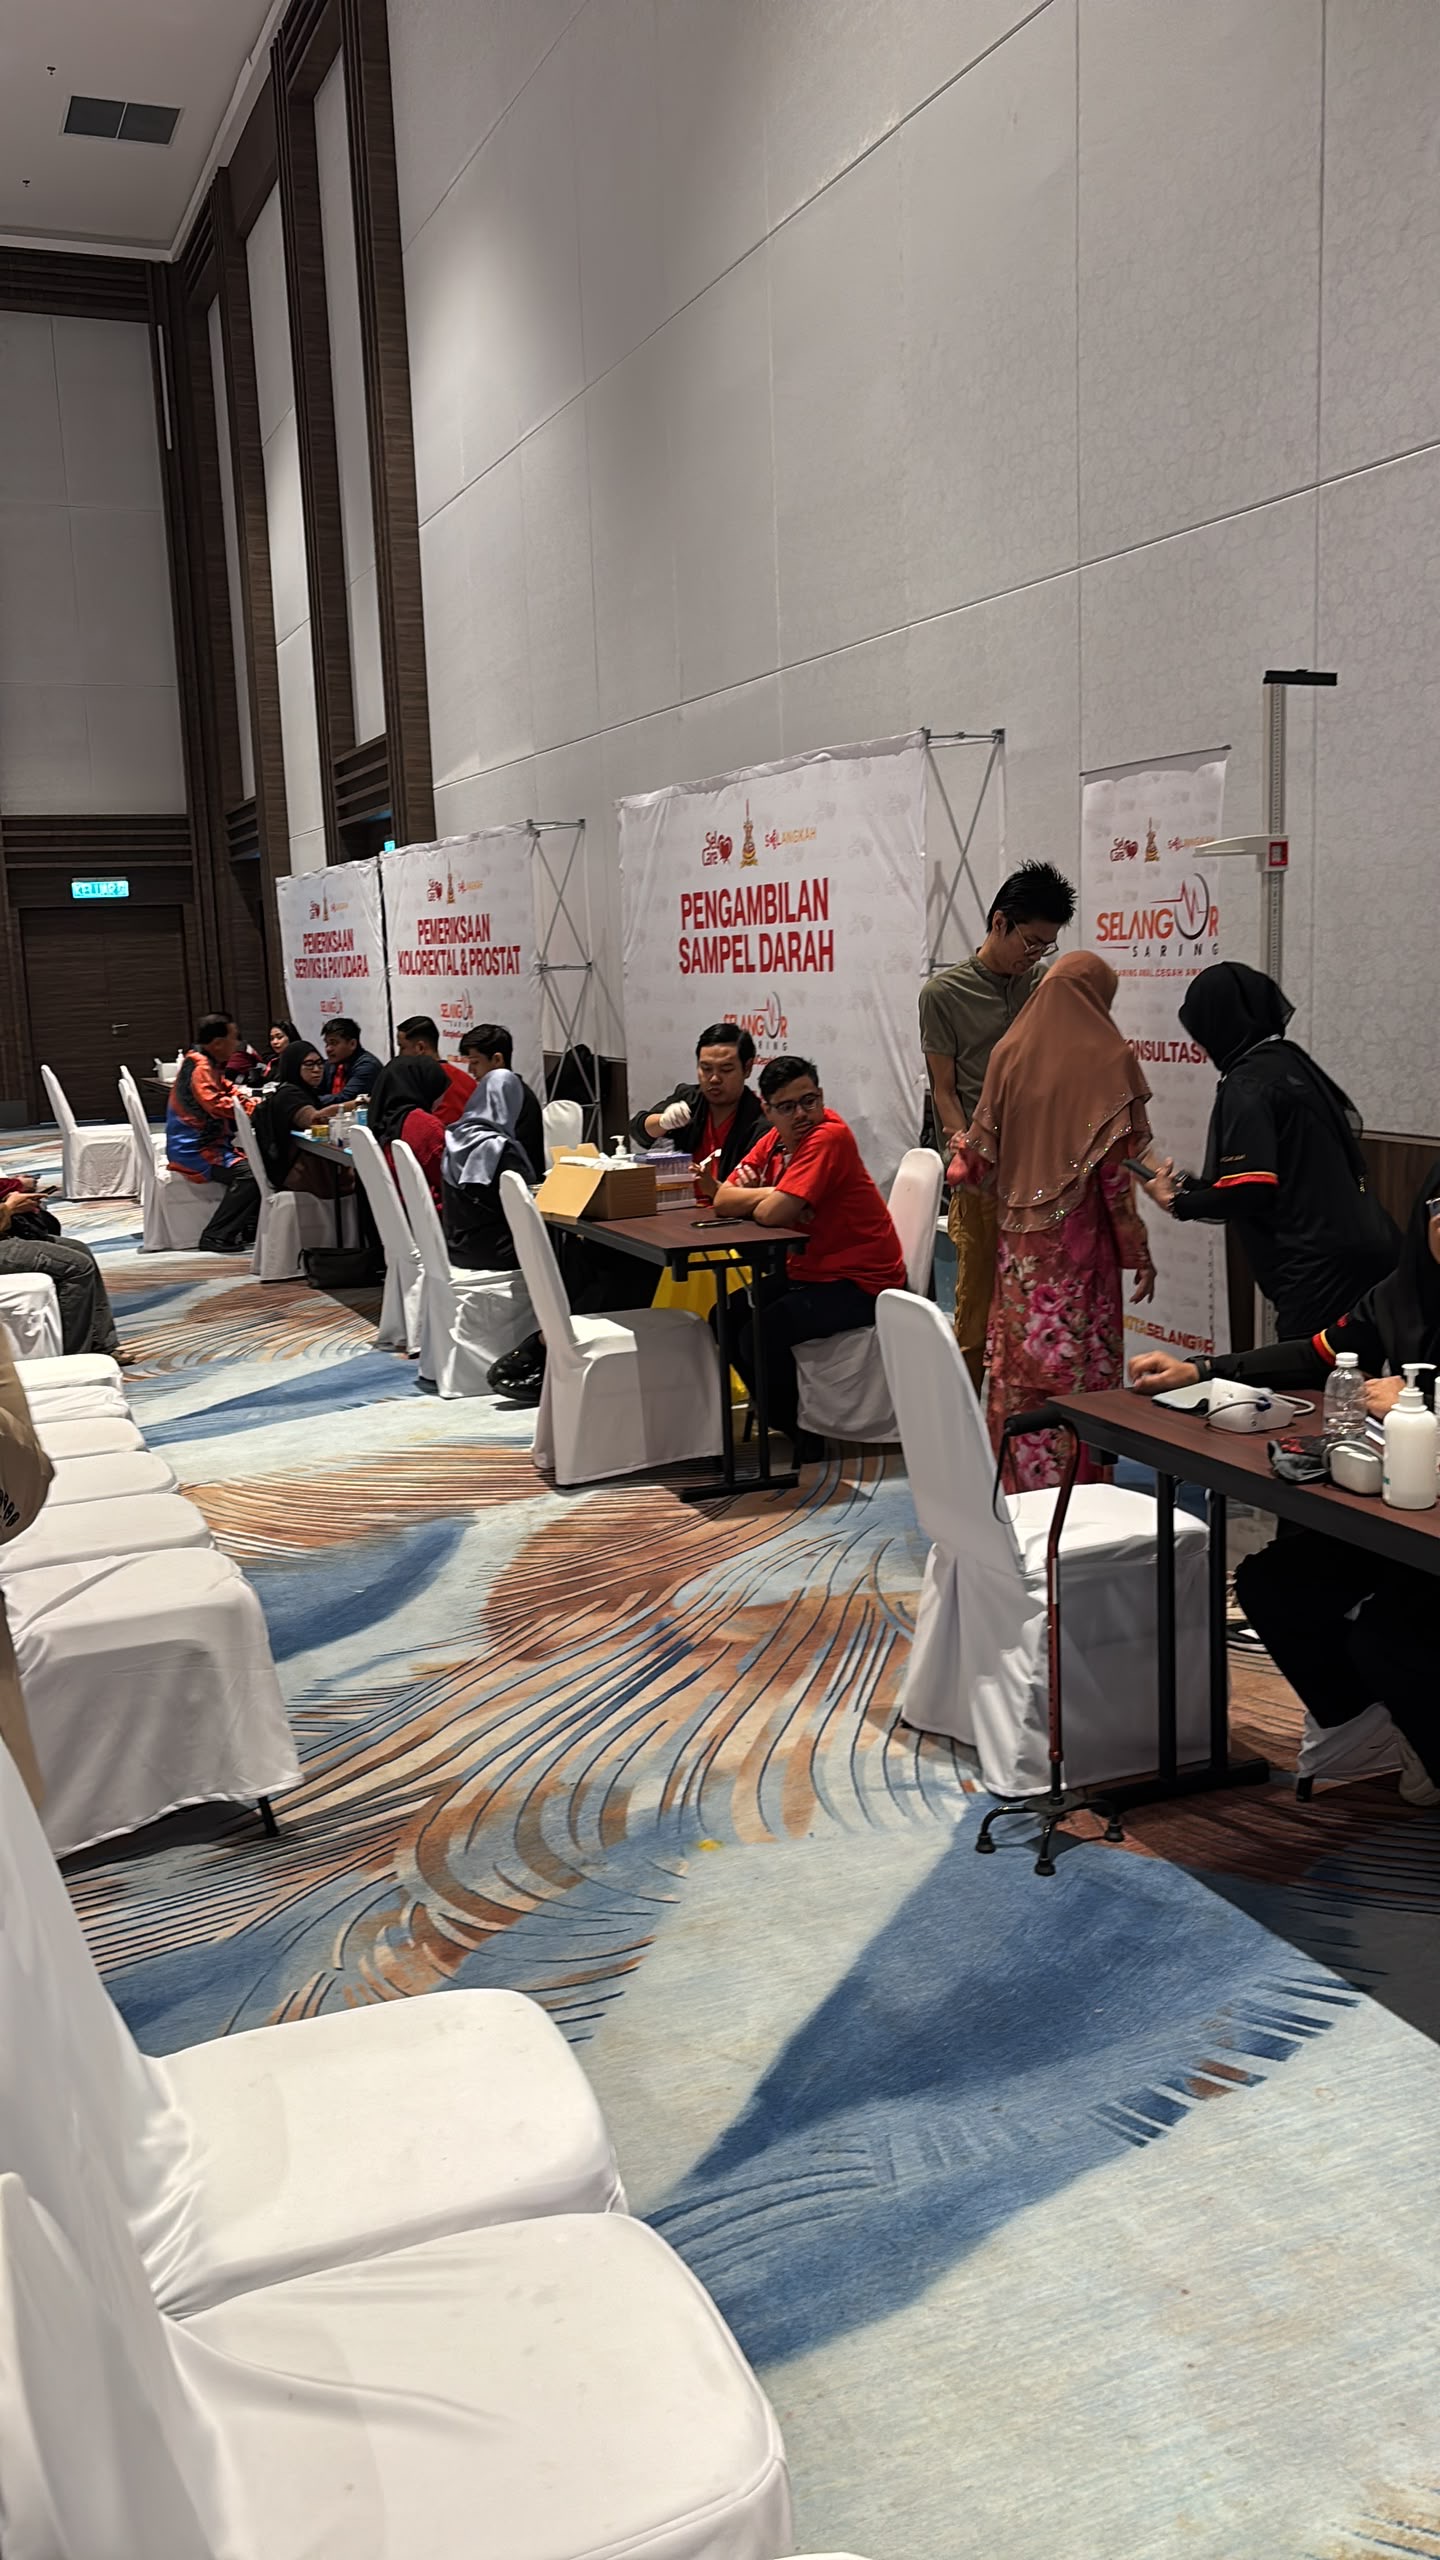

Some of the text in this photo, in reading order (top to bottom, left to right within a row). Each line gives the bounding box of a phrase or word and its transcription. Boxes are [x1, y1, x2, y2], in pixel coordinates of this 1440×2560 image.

[680, 877, 829, 931] PENGAMBILAN
[1096, 872, 1219, 941] SELANGOR
[417, 913, 491, 946] PEMERIKSAAN
[398, 945, 521, 976] KOLOREKTAL & PROSTAT
[679, 929, 834, 975] SAMPEL DARAH
[1132, 943, 1219, 958] SARING
[1124, 1039, 1207, 1064] ONSULTAS
